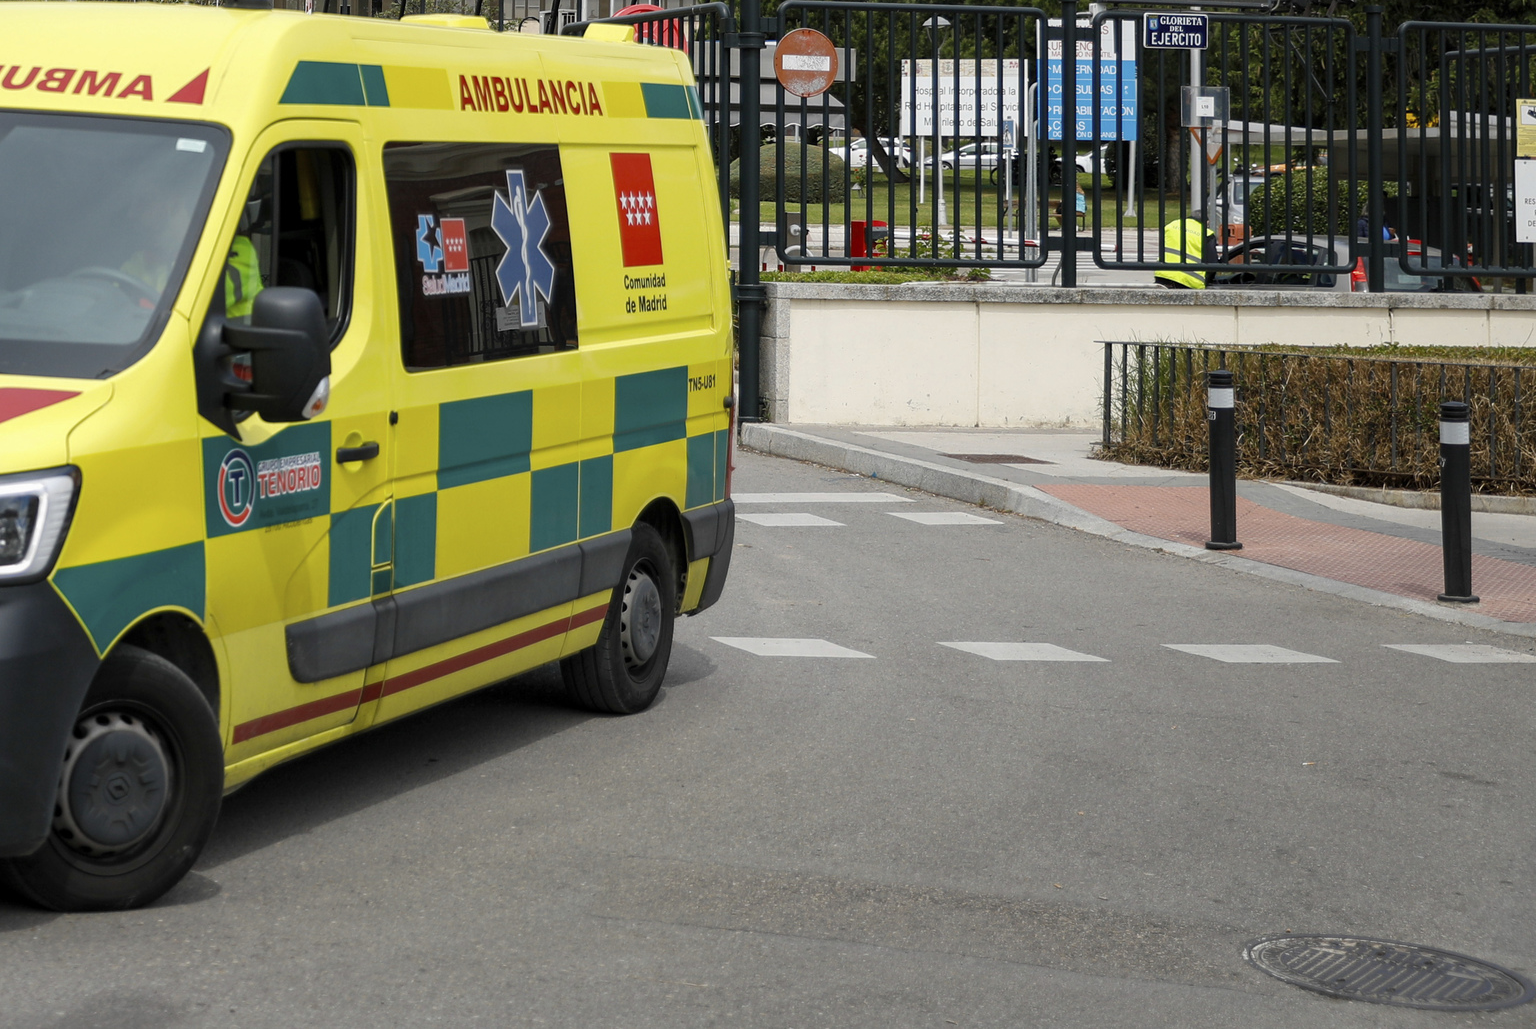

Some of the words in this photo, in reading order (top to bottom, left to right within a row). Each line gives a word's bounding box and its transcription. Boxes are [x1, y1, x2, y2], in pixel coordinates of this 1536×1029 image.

[1160, 16, 1203, 26] GLORIETA
[1151, 32, 1201, 46] EJERCITO
[1052, 64, 1117, 75] MERNAD
[458, 74, 604, 116] AMBULANCIA
[914, 87, 946, 98] Hospal
[1009, 87, 1016, 97] la
[1052, 84, 1113, 95] CSULAS
[904, 102, 922, 112] Rd
[924, 102, 973, 113] Hpitaaria
[1052, 104, 1134, 116] RABILACÓN
[923, 117, 964, 126] Mrileo
[980, 117, 998, 127] Salu
[624, 272, 666, 290] Comunidad
[625, 297, 636, 313] de
[638, 294, 667, 313] Madrid
[689, 374, 716, 392] TN5-U81
[257, 458, 279, 472] GRUPO
[228, 468, 245, 507] T
[257, 463, 322, 499] TENORIO
